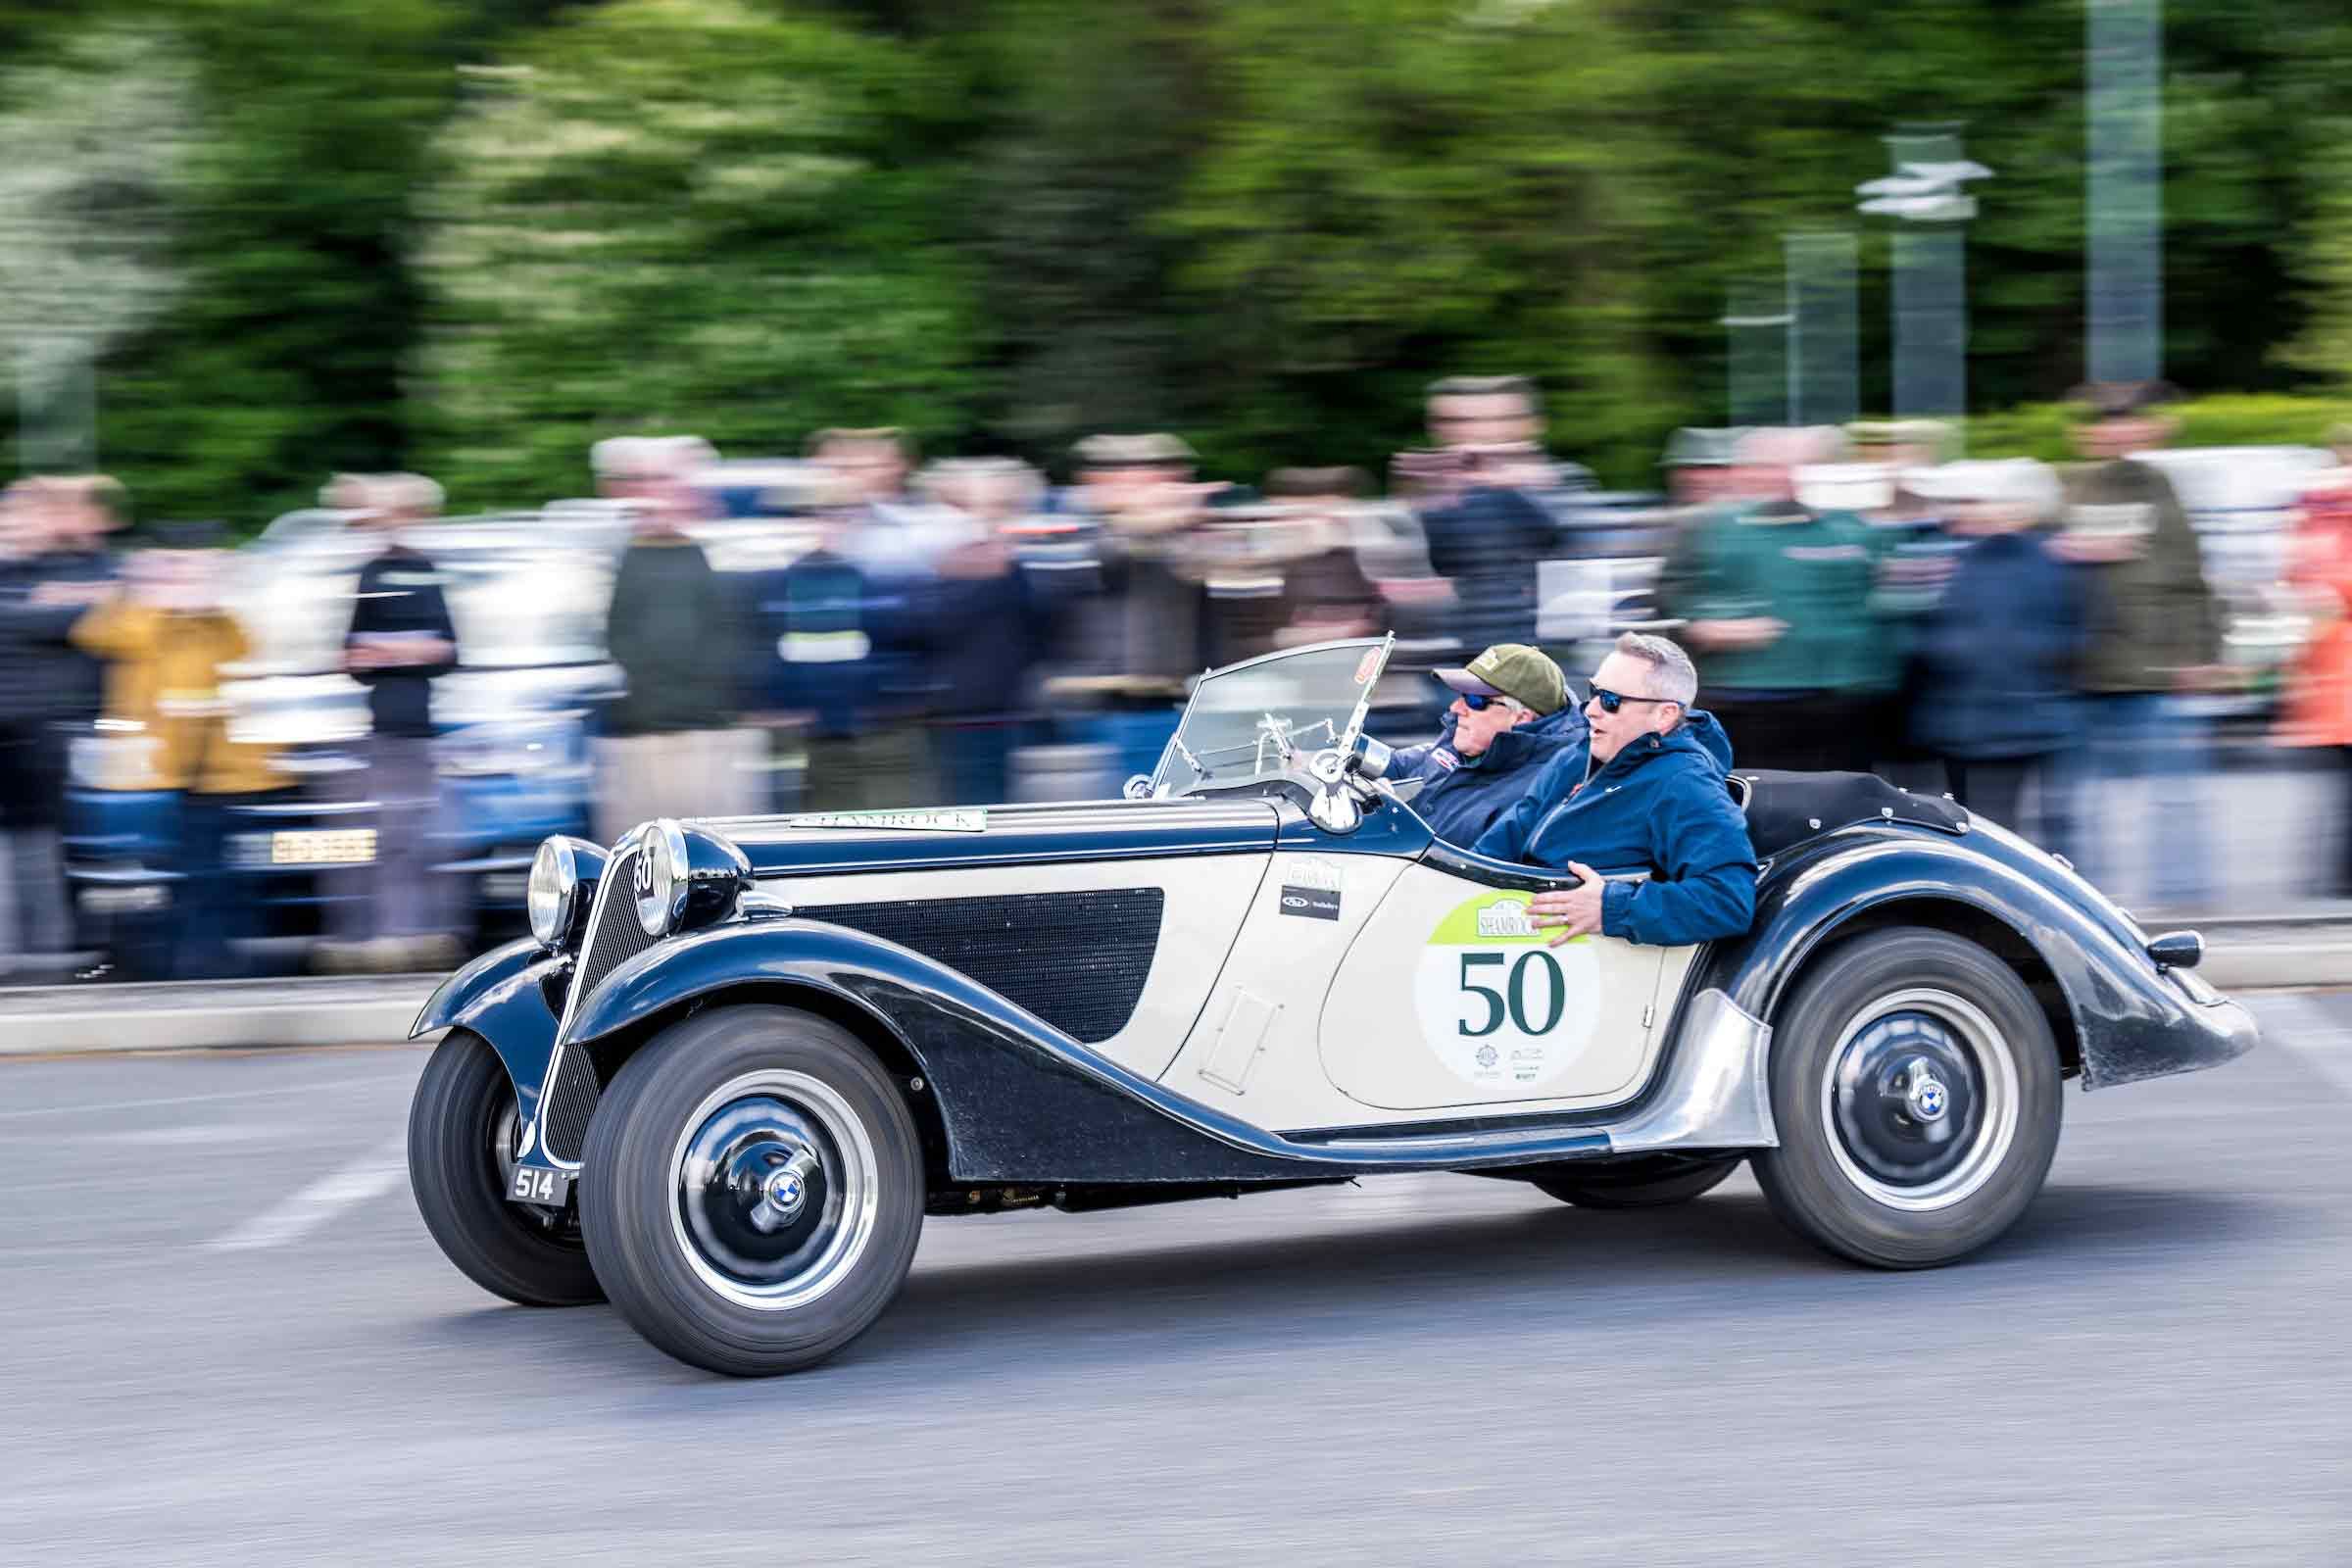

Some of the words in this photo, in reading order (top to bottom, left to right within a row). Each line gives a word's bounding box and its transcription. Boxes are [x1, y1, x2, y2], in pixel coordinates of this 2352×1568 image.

[800, 813, 971, 827] HAMROCK
[1458, 950, 1566, 1036] 50
[515, 1168, 554, 1200] 514
